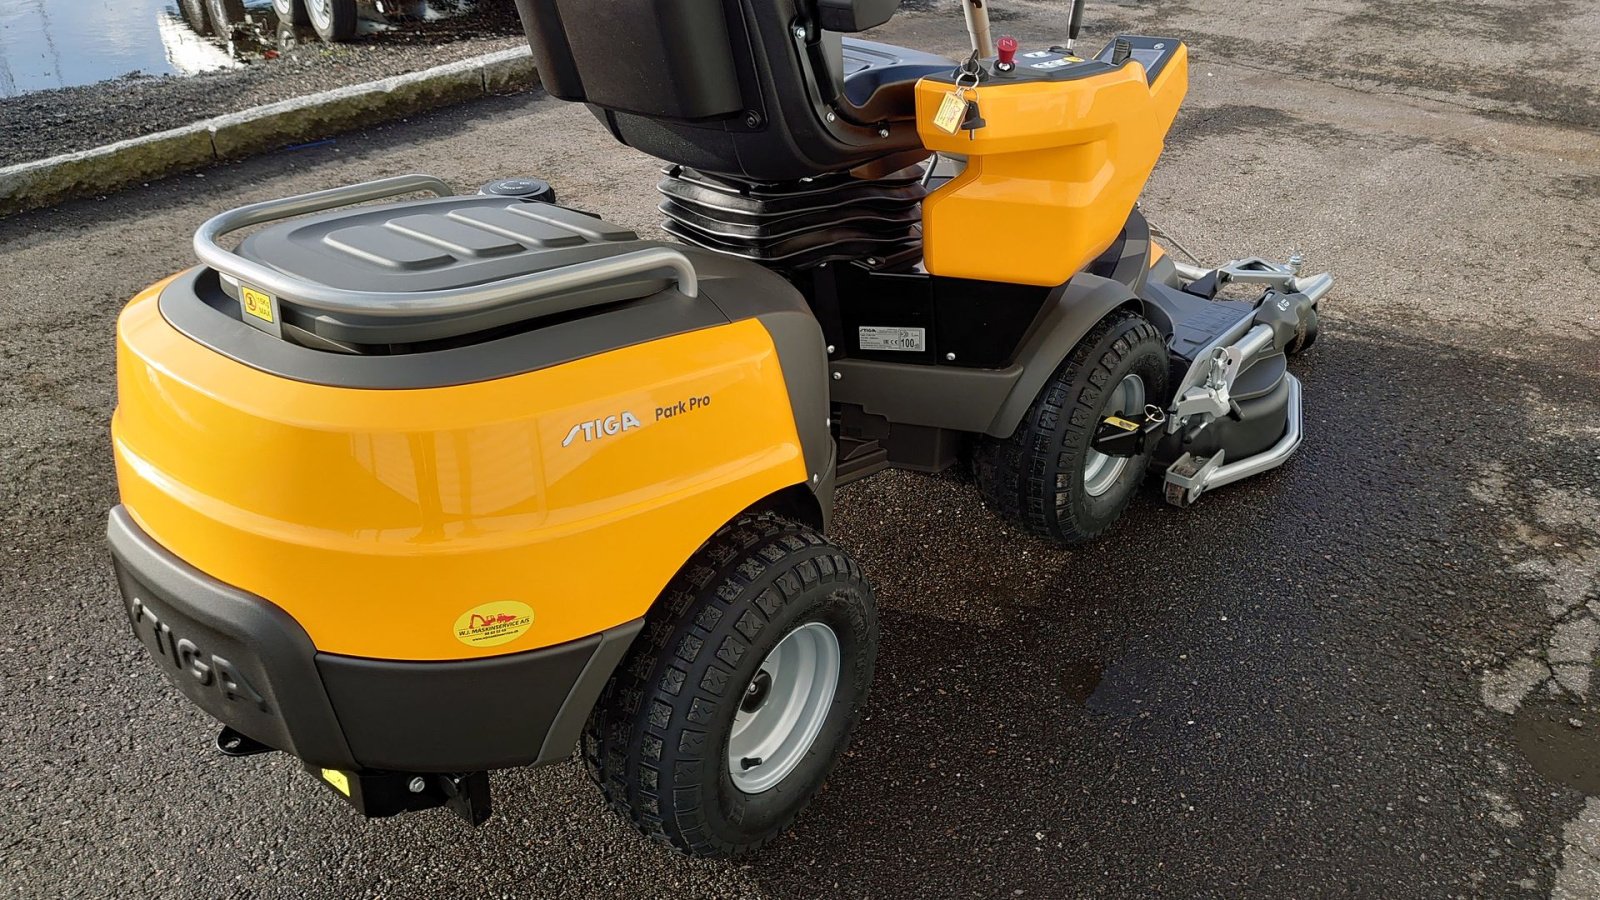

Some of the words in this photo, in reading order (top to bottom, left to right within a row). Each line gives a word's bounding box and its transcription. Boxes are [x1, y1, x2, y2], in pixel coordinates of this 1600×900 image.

[900, 338, 915, 348] 100
[655, 400, 686, 421] Park
[689, 396, 711, 411] Pro
[562, 411, 641, 447] STIGA
[472, 620, 519, 634] MASKINSERVICE
[131, 597, 268, 713] STIGA
